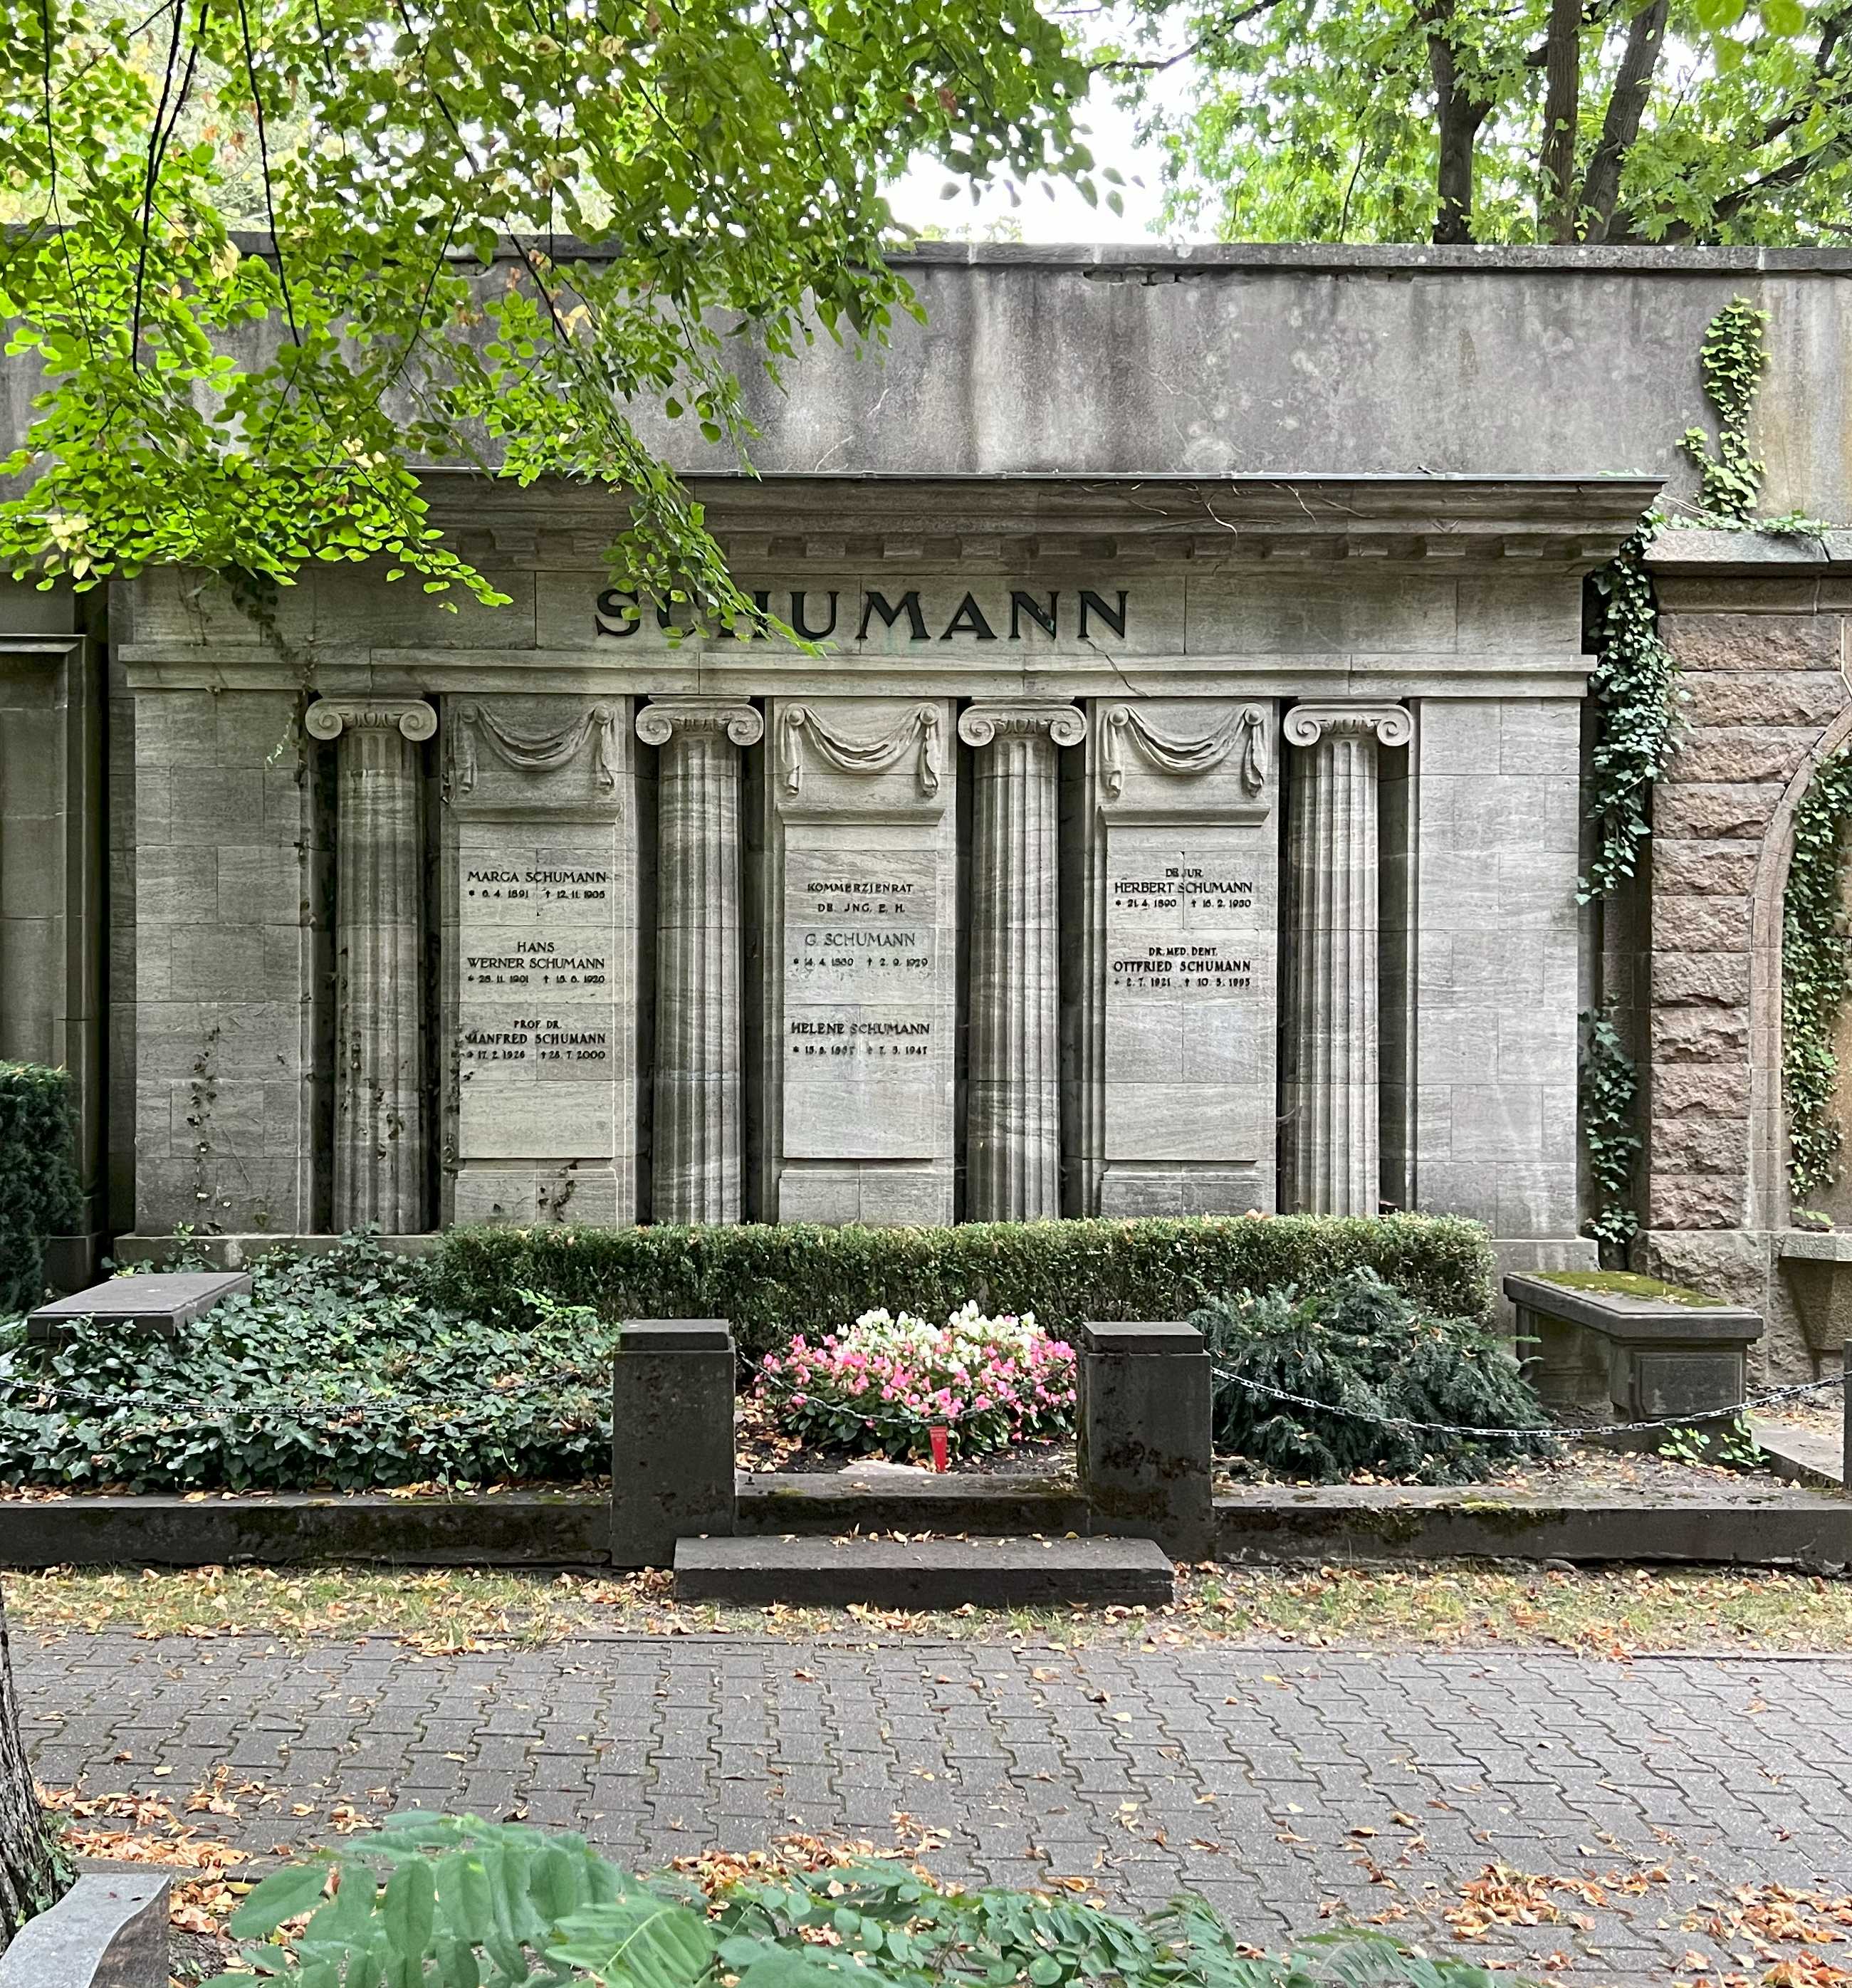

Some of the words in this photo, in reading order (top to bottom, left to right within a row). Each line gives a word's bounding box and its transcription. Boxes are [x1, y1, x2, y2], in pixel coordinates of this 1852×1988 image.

[468, 872, 519, 882] MARGA
[525, 872, 607, 882] SCHUMANN
[1115, 882, 1174, 893] HERBERT
[1178, 882, 1252, 893] SCHUMANN
[824, 933, 915, 947] SCHUMANN
[518, 942, 555, 952] HANS
[467, 958, 525, 968] WERNER
[530, 958, 604, 968] SCHUMANN
[1114, 961, 1172, 972] OTTFRIED
[1180, 961, 1250, 972] SCHUMANN
[791, 1022, 844, 1034] HELENE
[850, 1023, 930, 1035] SCHUMANN
[465, 1034, 527, 1044] MANFRED
[535, 1034, 605, 1044] SCHUMANN
